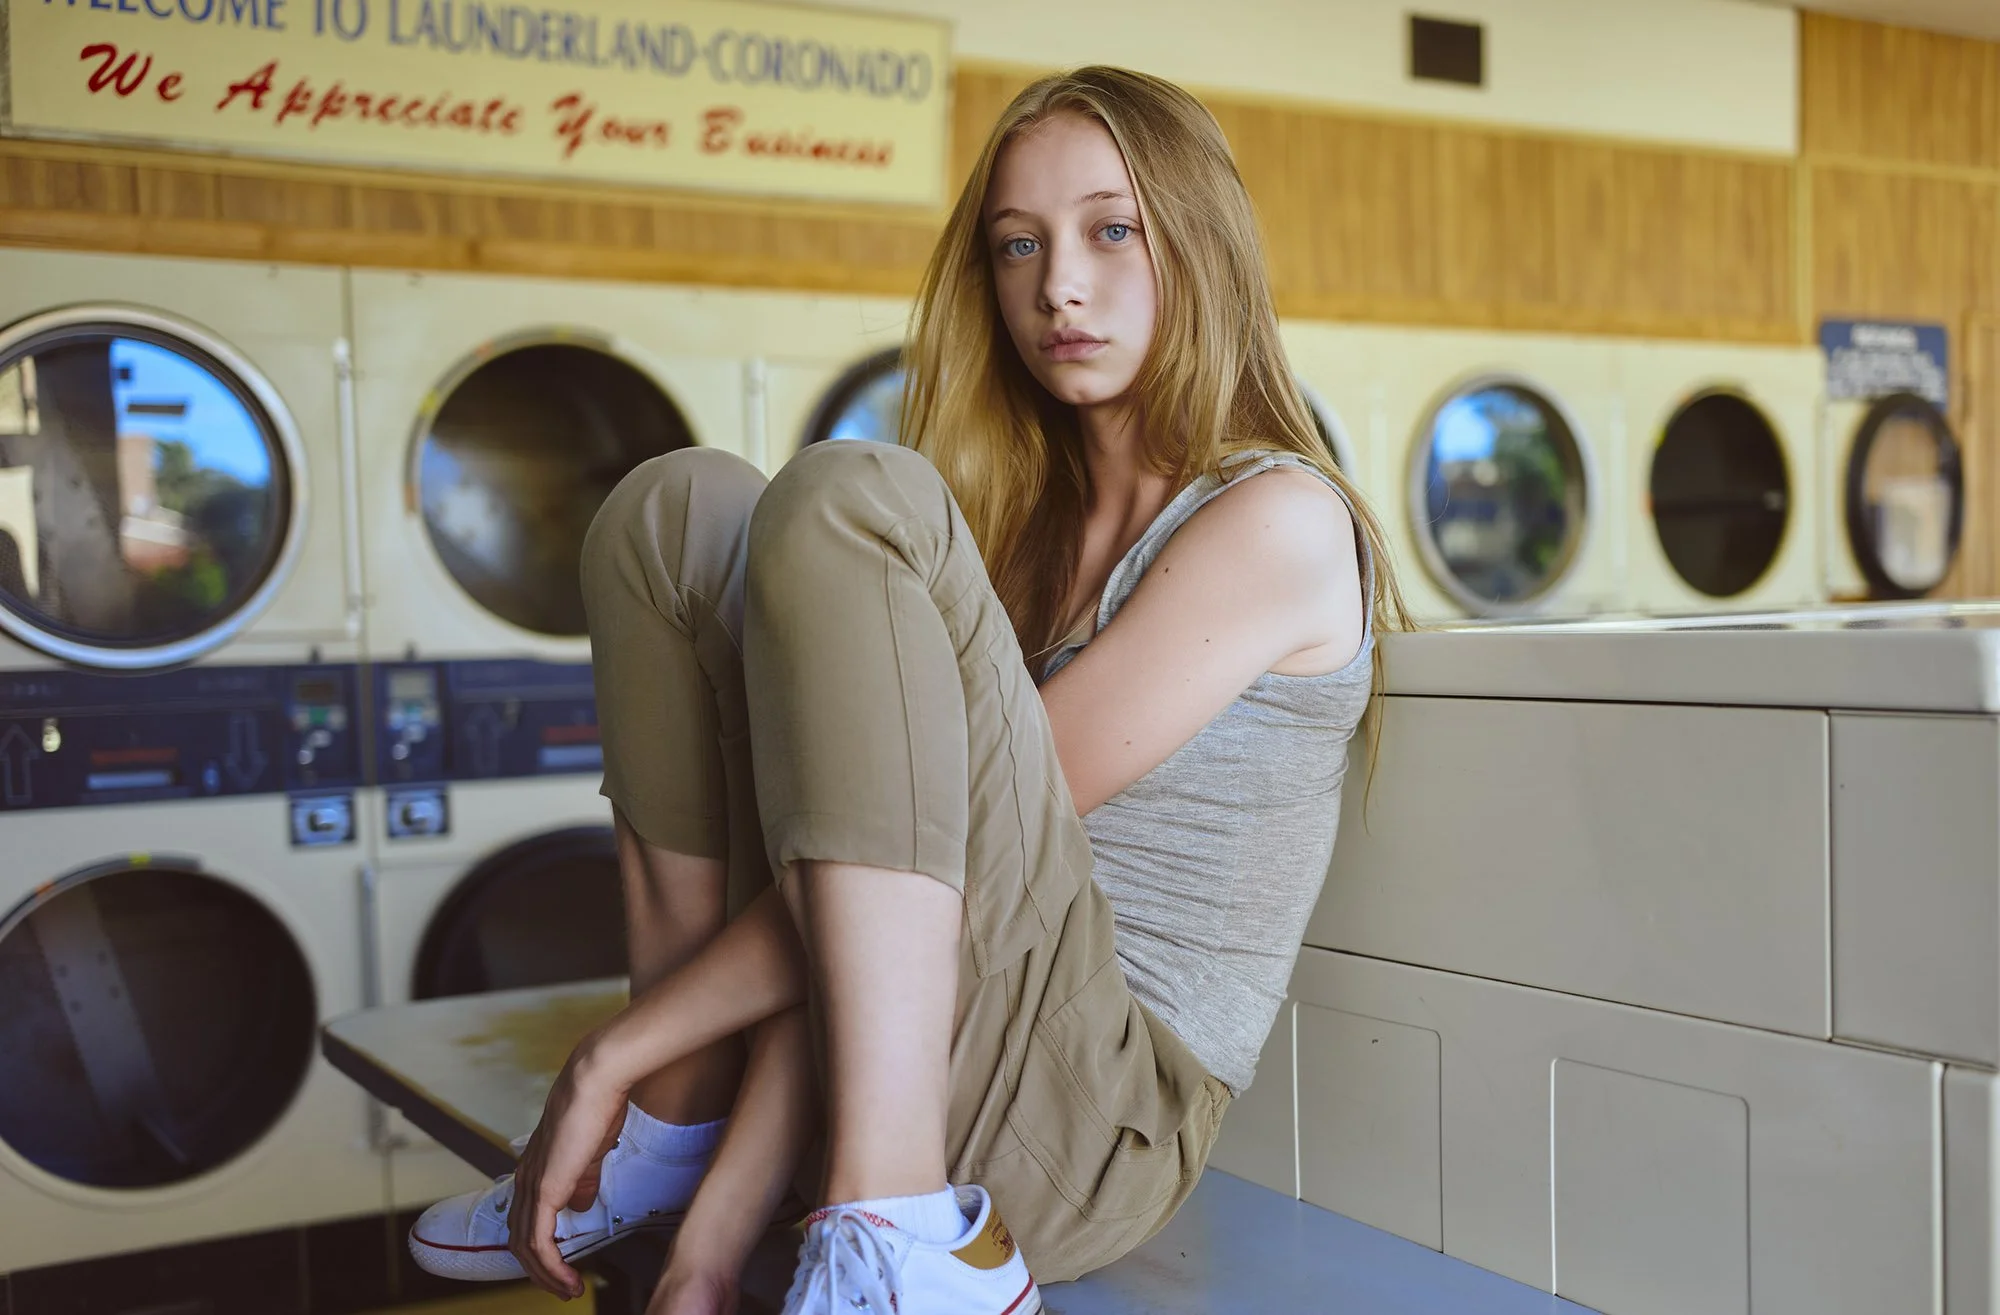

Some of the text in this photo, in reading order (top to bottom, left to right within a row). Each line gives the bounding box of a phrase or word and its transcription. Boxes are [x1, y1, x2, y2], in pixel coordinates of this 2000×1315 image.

[79, 43, 892, 167] We Appreciate Your Business
